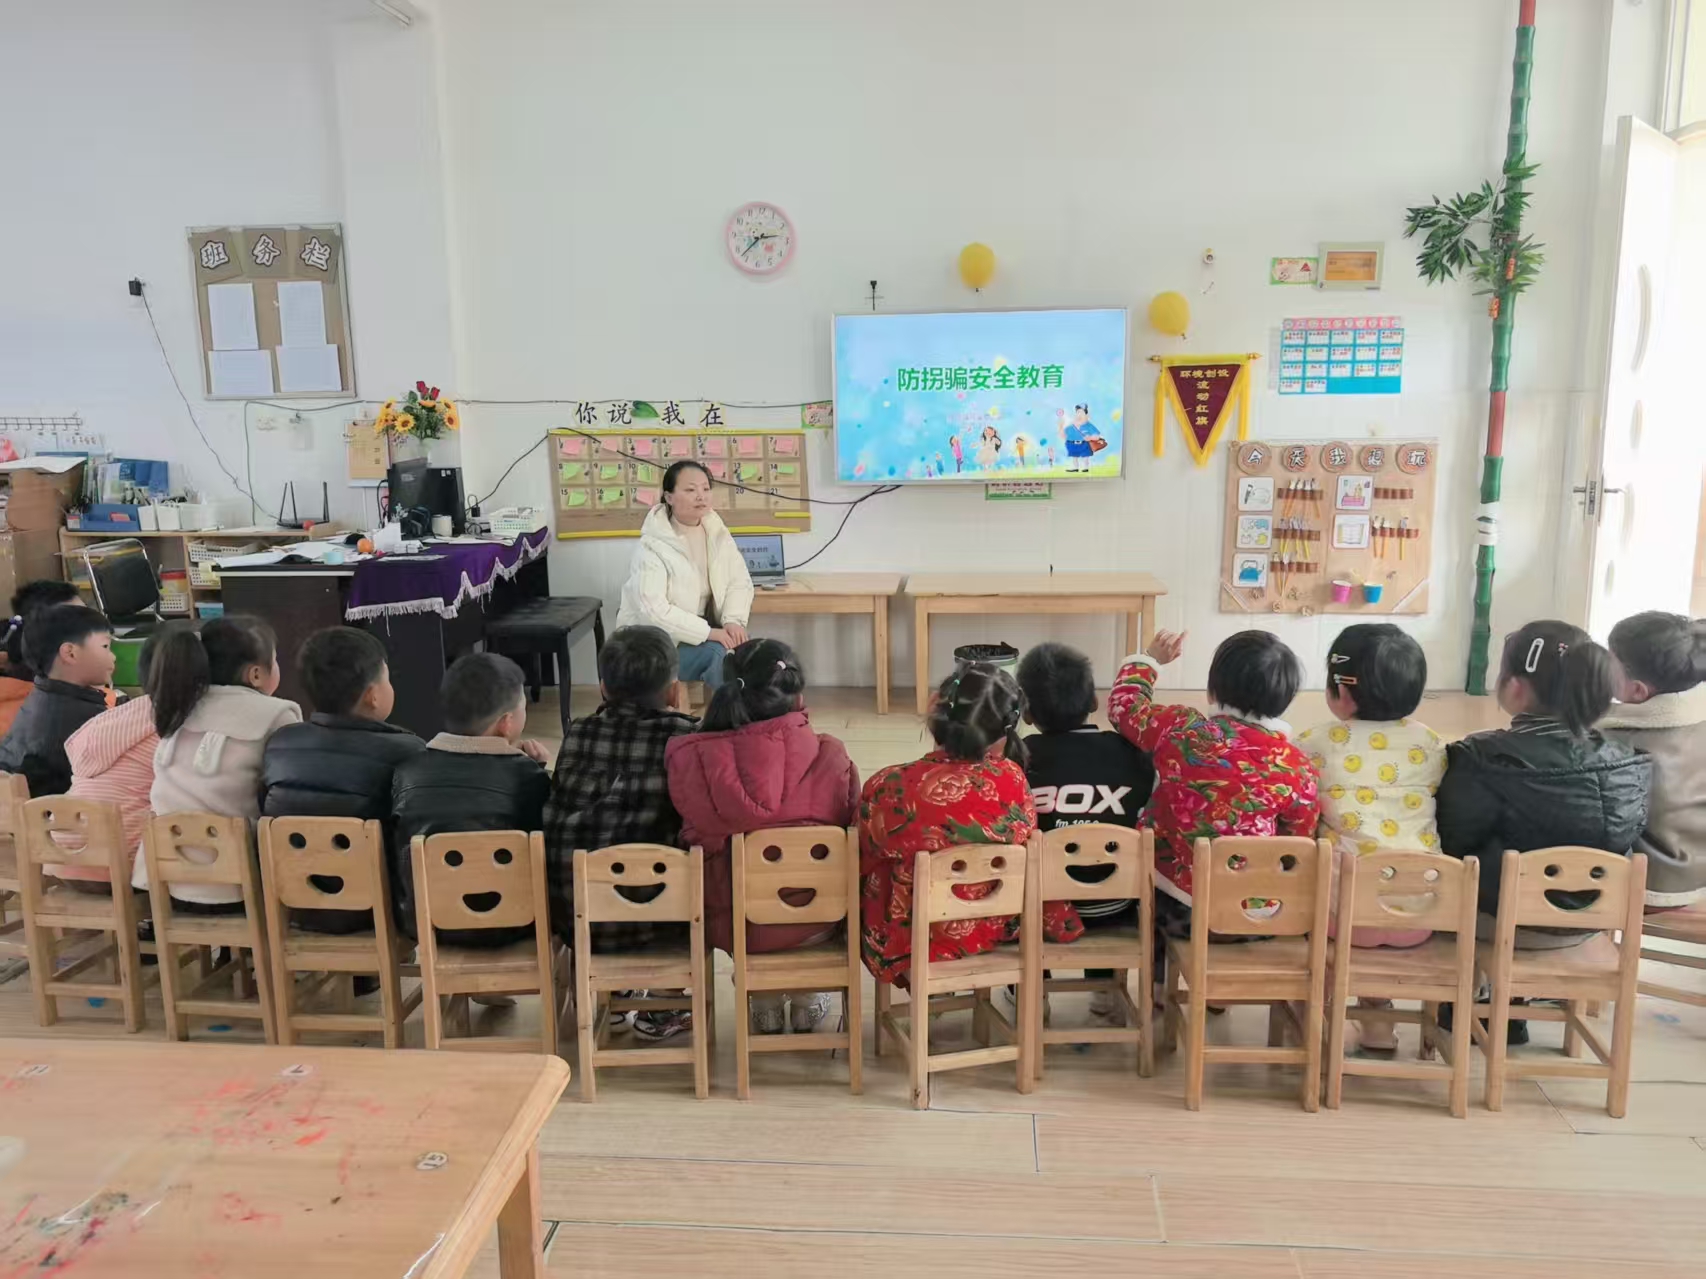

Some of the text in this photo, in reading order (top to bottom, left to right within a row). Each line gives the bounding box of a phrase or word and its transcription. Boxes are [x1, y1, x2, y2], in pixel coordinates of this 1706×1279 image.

[201, 234, 331, 271] 班务栏
[897, 364, 1064, 392] 防拐骗安全教育
[1247, 447, 1427, 467] 今天我想玩
[1032, 784, 1132, 815] BOX
